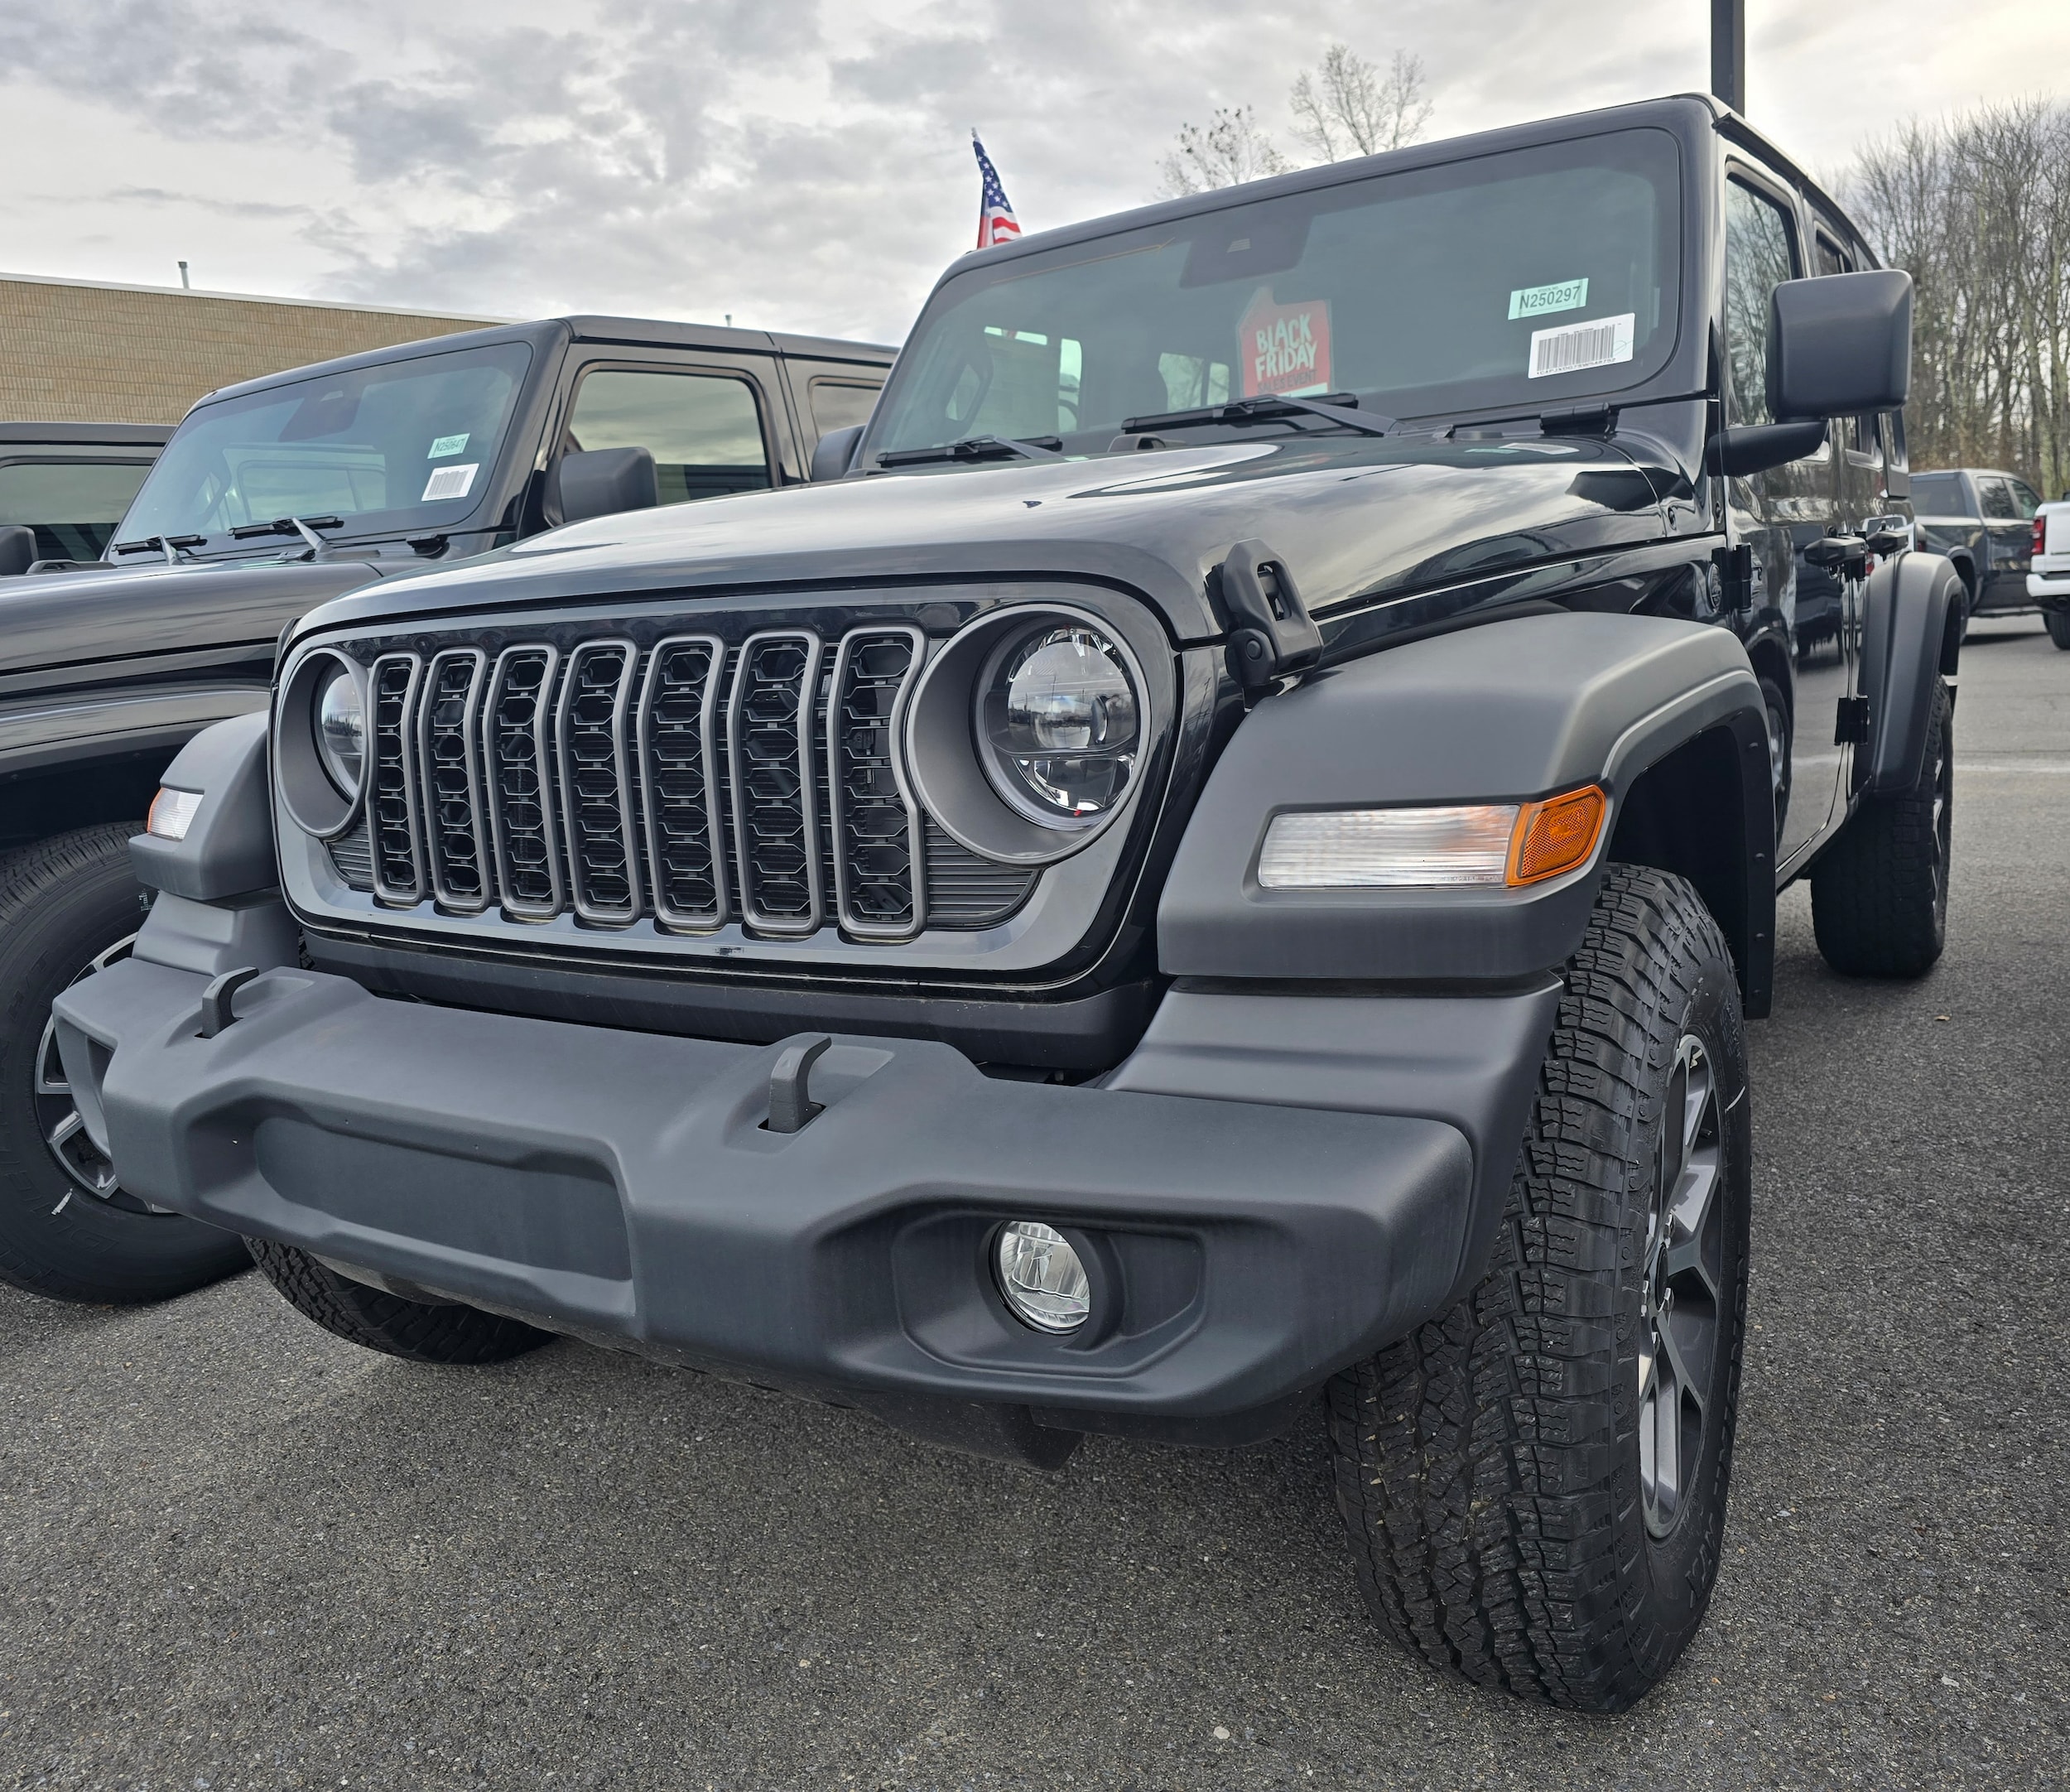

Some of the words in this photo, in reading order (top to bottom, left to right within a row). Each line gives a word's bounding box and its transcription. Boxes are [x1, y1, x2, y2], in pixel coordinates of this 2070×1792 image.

[1519, 286, 1581, 309] N250297
[1255, 313, 1312, 354] BLACK
[1254, 340, 1318, 381] FRIDAY
[1258, 379, 1285, 393] SALES
[1288, 369, 1317, 387] EVENT
